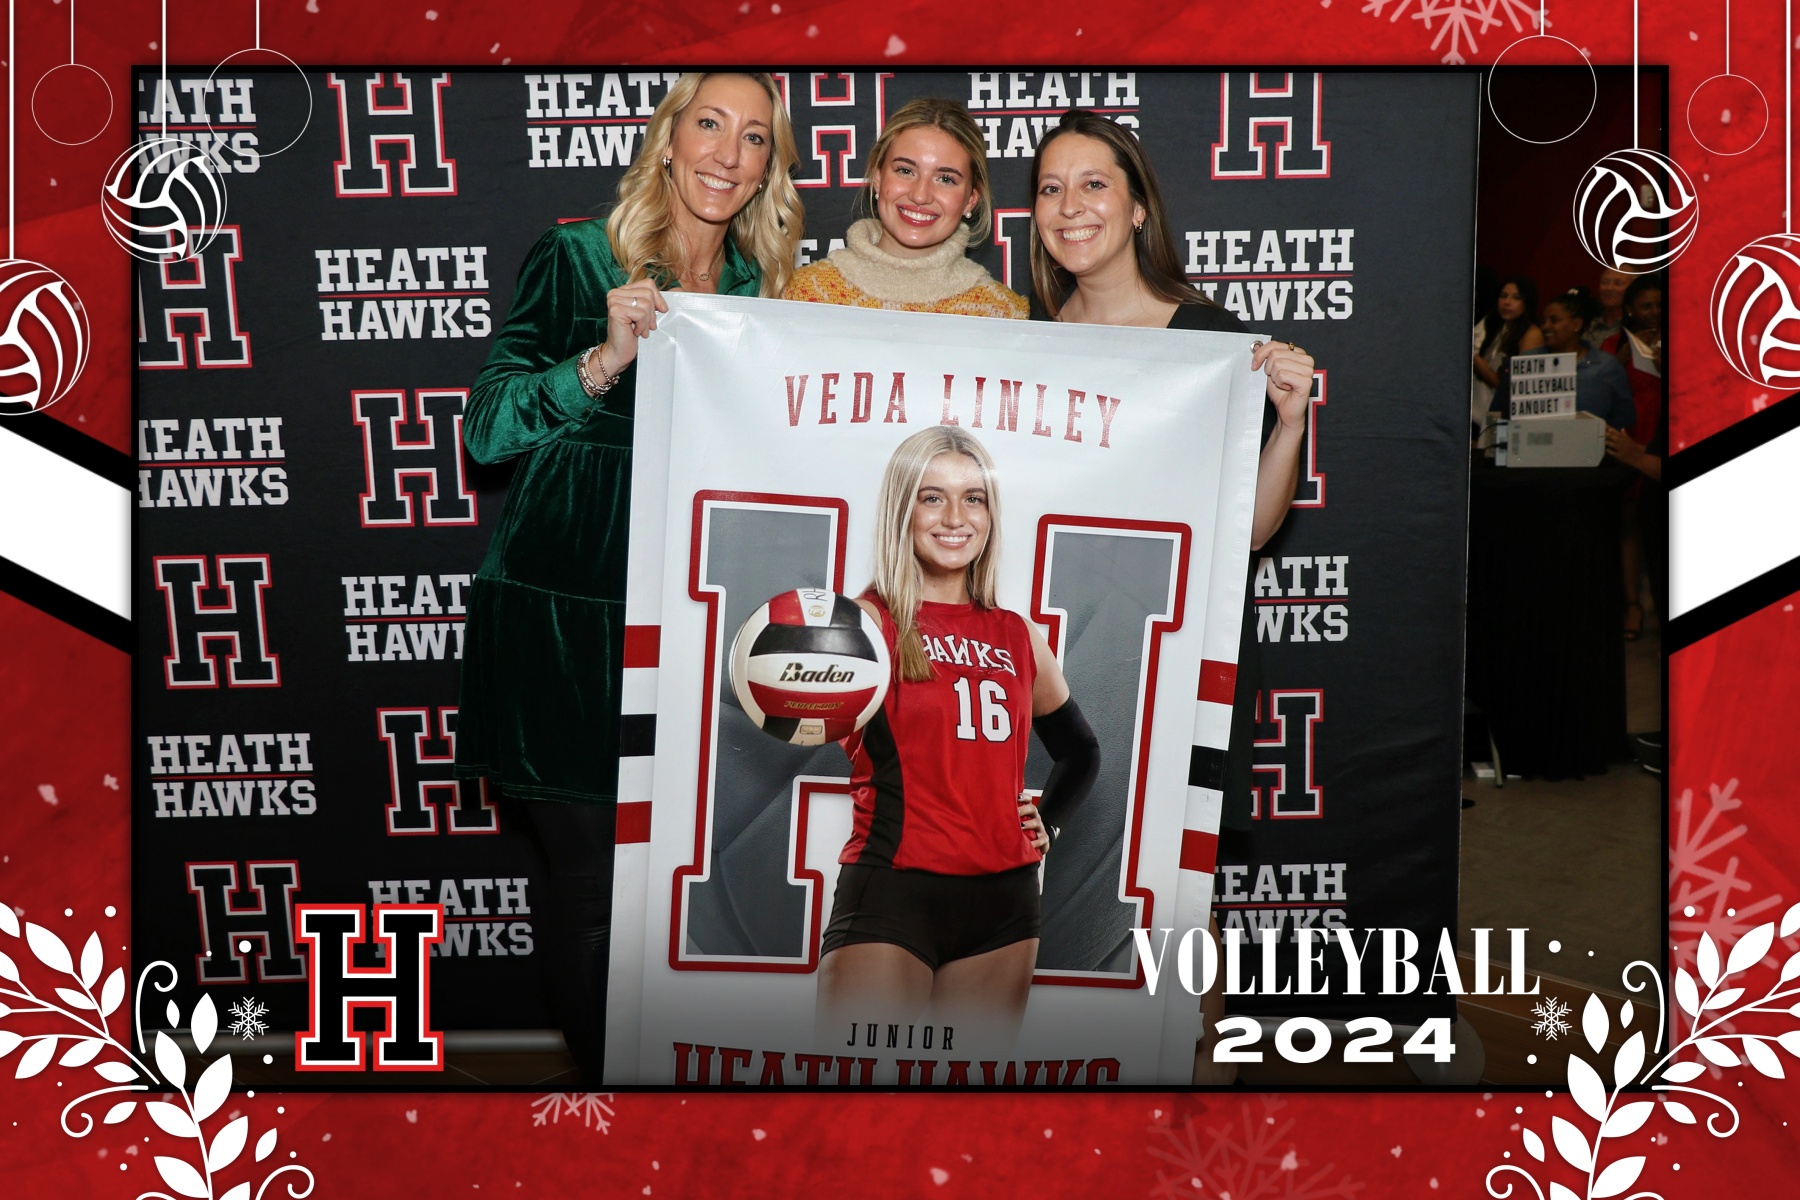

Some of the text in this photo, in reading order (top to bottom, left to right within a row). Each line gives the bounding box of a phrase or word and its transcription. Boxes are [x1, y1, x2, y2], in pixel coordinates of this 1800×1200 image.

[139, 79, 257, 123] ATH
[967, 72, 1140, 109] HEATH
[527, 125, 647, 168] HAW
[315, 246, 490, 292] HEATH
[1185, 229, 1355, 274] HEATH
[320, 298, 492, 341] HAWKS
[1511, 376, 1575, 395] VOLLEYBALL
[1513, 358, 1546, 374] HEATH
[784, 372, 1122, 449] VEDA LINLEY
[1511, 398, 1559, 416] BANQUET
[341, 574, 477, 616] HEAT
[1254, 555, 1349, 597] ATH
[1255, 604, 1349, 642] WKS
[779, 662, 855, 683] Baden
[953, 676, 1013, 742] 16
[148, 733, 313, 774] HEATH
[154, 779, 317, 818] HAWKS
[1212, 863, 1347, 902] EATH
[1214, 908, 1347, 944] AWKS
[847, 1022, 954, 1050] JUNIOR
